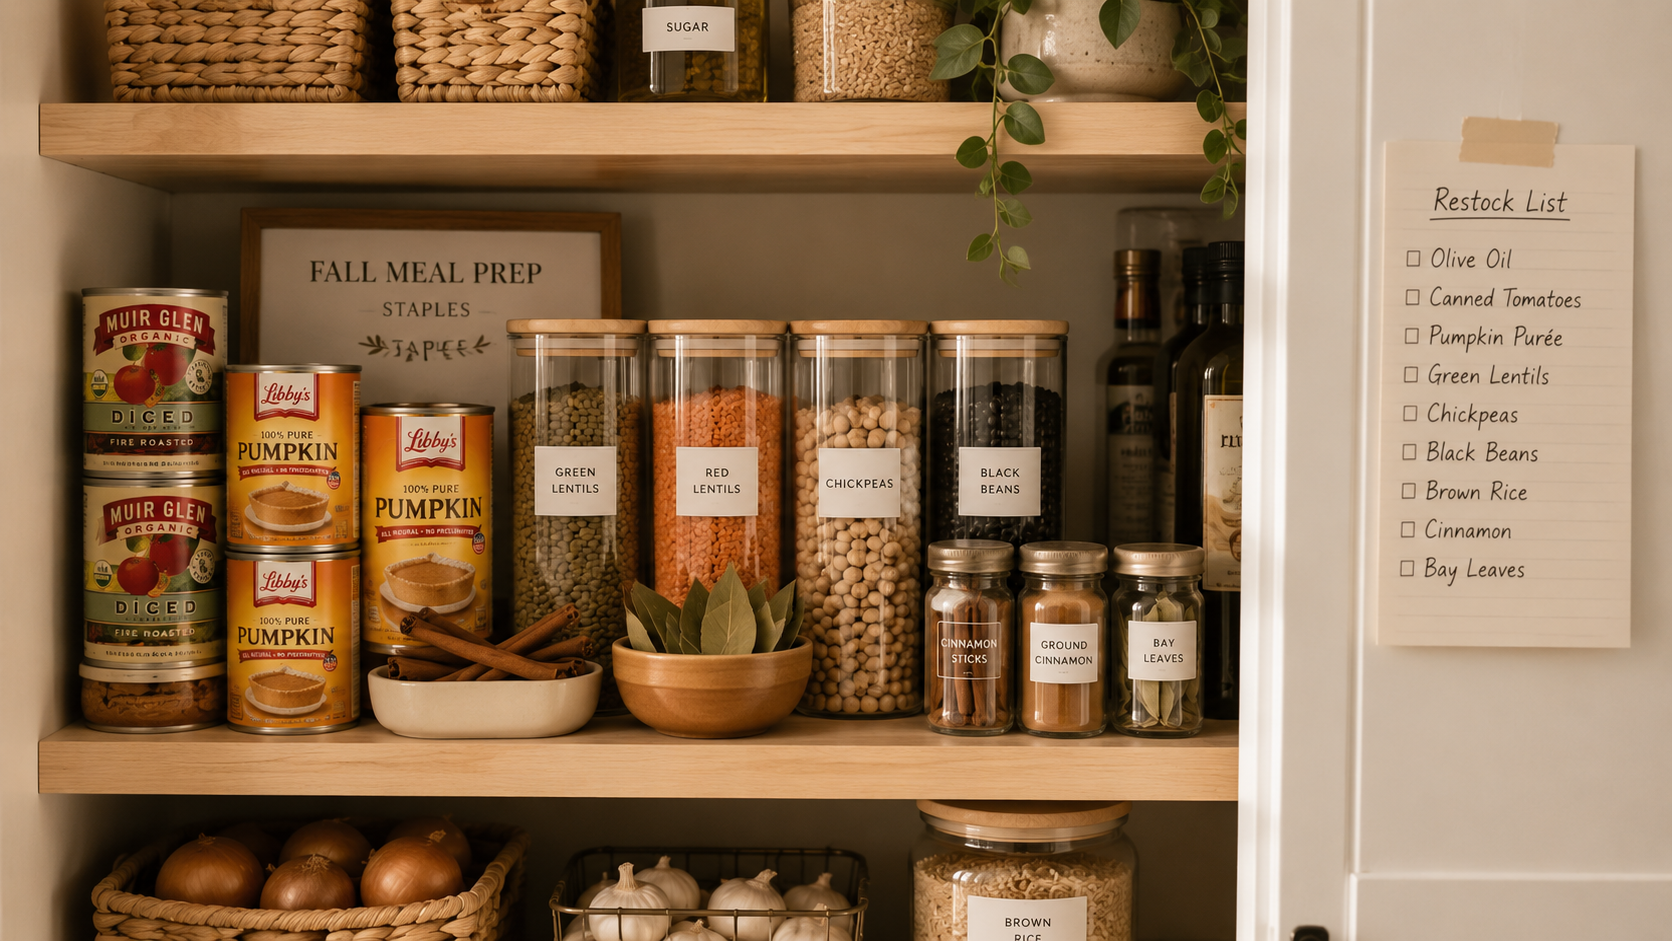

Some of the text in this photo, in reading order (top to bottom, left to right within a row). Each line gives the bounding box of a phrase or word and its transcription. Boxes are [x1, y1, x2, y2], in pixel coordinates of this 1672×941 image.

[666, 21, 709, 33] SUGAR
[1434, 186, 1568, 213] Restock List
[1430, 247, 1512, 269] Olive Oil
[310, 260, 542, 284] FALL MEAL PREP
[1429, 286, 1582, 308] Canned Tomatoes
[382, 301, 470, 318] STAPLES
[106, 309, 204, 335] MUIR GLEN
[119, 332, 190, 344] ORGANIC
[1429, 324, 1563, 353] Pumpkin Purée
[1428, 363, 1549, 385] Green Lentils
[260, 382, 311, 405] Libby's
[111, 409, 194, 424] DICED
[1427, 402, 1518, 431] Chickpeas
[110, 438, 135, 447] FIRE
[261, 430, 313, 440] 100% PURE
[403, 427, 458, 453] Libby's
[238, 442, 338, 461] PUMPKIN
[1426, 440, 1538, 462] Black Beans
[555, 467, 596, 478] GREEN
[705, 467, 729, 478] RED
[980, 467, 1020, 478] BLACK
[403, 484, 460, 494] 100% PURE
[552, 484, 599, 494] LENTILS
[693, 484, 741, 494] LENTILS
[825, 478, 894, 489] CHICKPEAS
[980, 484, 1020, 494] BEANS
[1425, 479, 1528, 501] Brown Rice
[110, 500, 155, 525] MUIR
[163, 500, 206, 524] GLEN
[375, 496, 483, 519] PUMPKIN
[124, 523, 193, 535] ORGANIC
[1424, 518, 1512, 539] Cinnamon
[1424, 557, 1525, 587] Bay Leaves
[259, 570, 308, 592] Libby's
[115, 600, 196, 615] DICED
[259, 616, 310, 625] 100% PURE
[238, 626, 335, 646] PUMPKIN
[940, 638, 998, 649] CINNAMON
[1153, 638, 1175, 648] BAY
[1040, 640, 1088, 650] GROUND
[951, 653, 988, 664] STICKS
[1034, 655, 1093, 666] CINNAMON
[1143, 653, 1184, 663] LEAVES
[1005, 917, 1051, 927] BROWN
